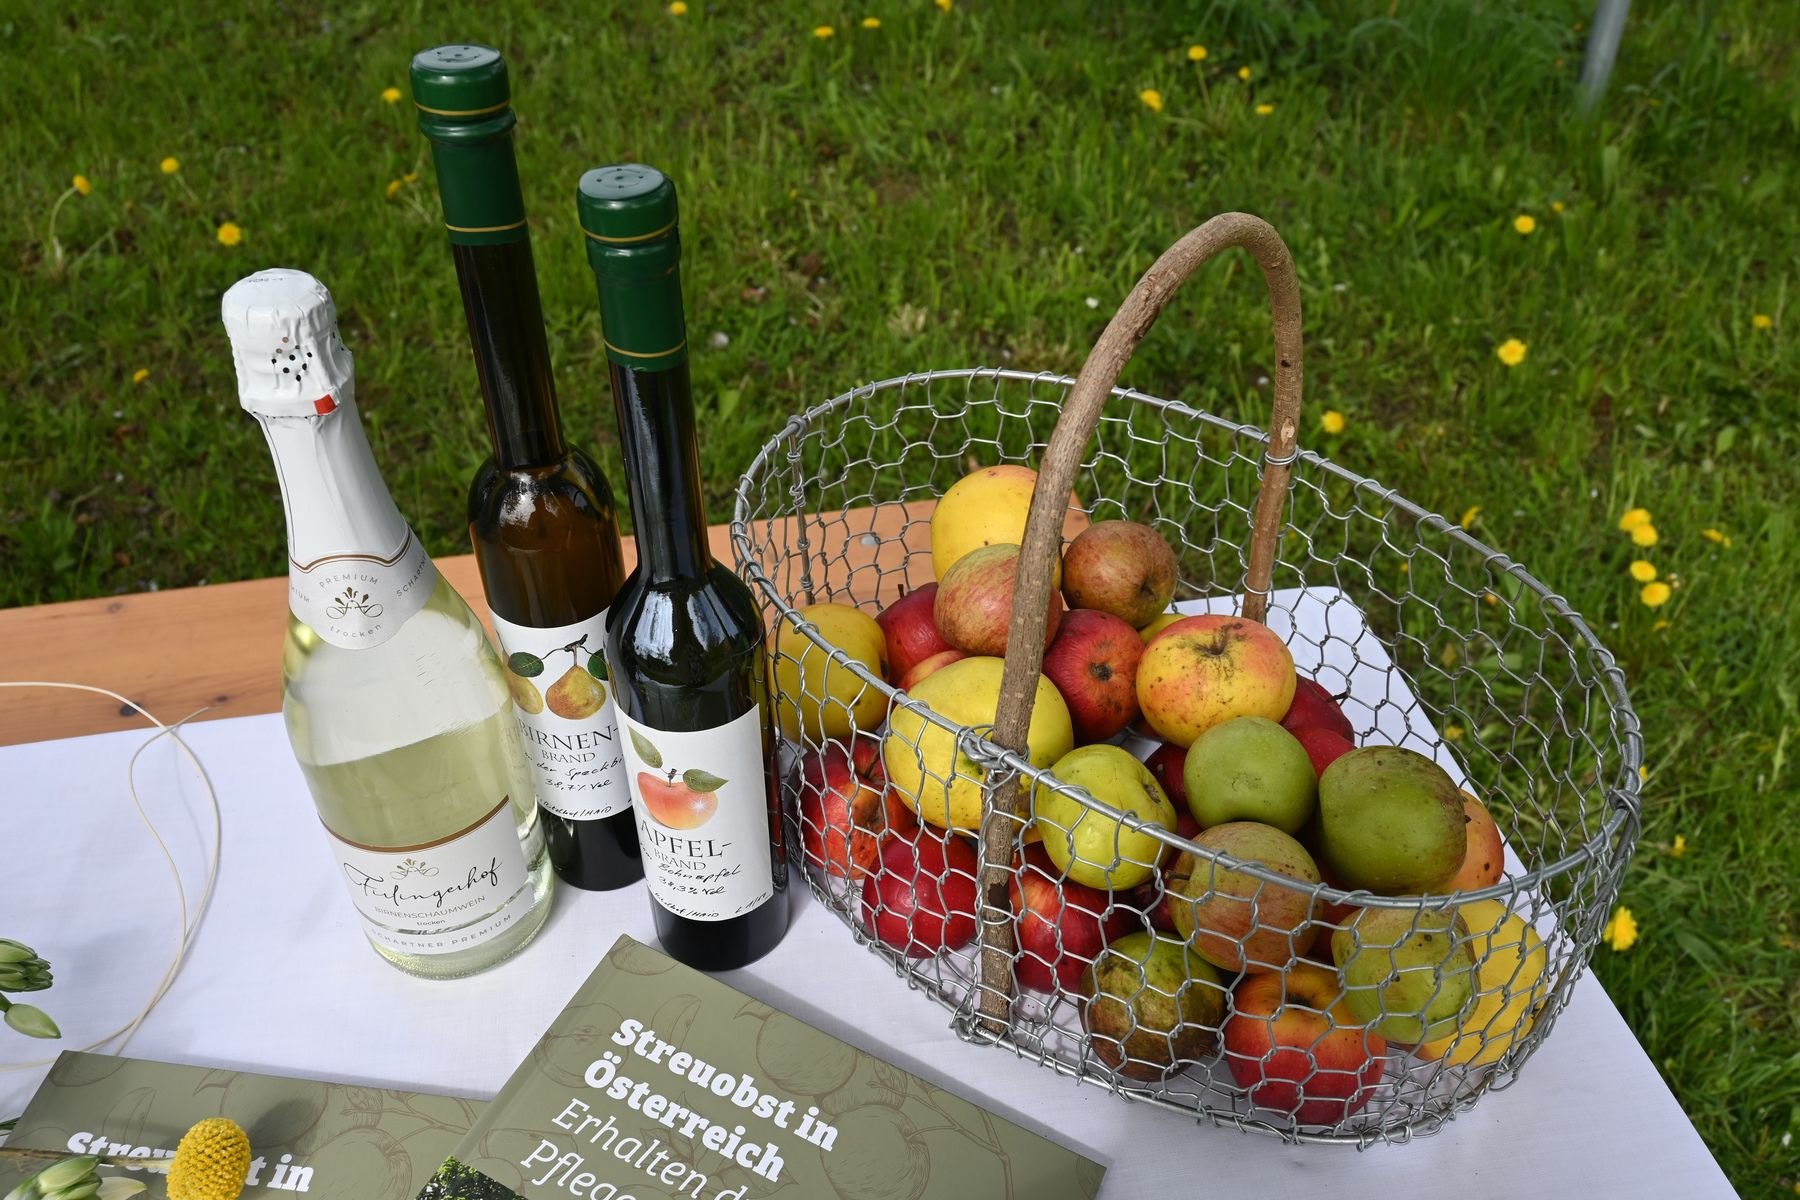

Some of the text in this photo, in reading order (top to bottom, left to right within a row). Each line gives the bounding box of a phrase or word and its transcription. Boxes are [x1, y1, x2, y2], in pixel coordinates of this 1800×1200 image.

[319, 573, 379, 588] PREMIUM
[330, 624, 382, 638] trocken
[518, 718, 618, 751] BIRNEN-
[541, 749, 596, 764] BRAND
[640, 819, 732, 858] APFEL-
[654, 848, 706, 871] BRAND
[374, 895, 486, 919] BIRNENSCHAUMWEIN
[416, 918, 446, 926] trocken
[371, 914, 512, 948] SCHARTNER PREMIUM
[611, 1018, 839, 1152] Streuobst in
[584, 1050, 785, 1183] Österreich
[552, 1098, 708, 1199] Erhalten
[267, 1153, 315, 1193] in
